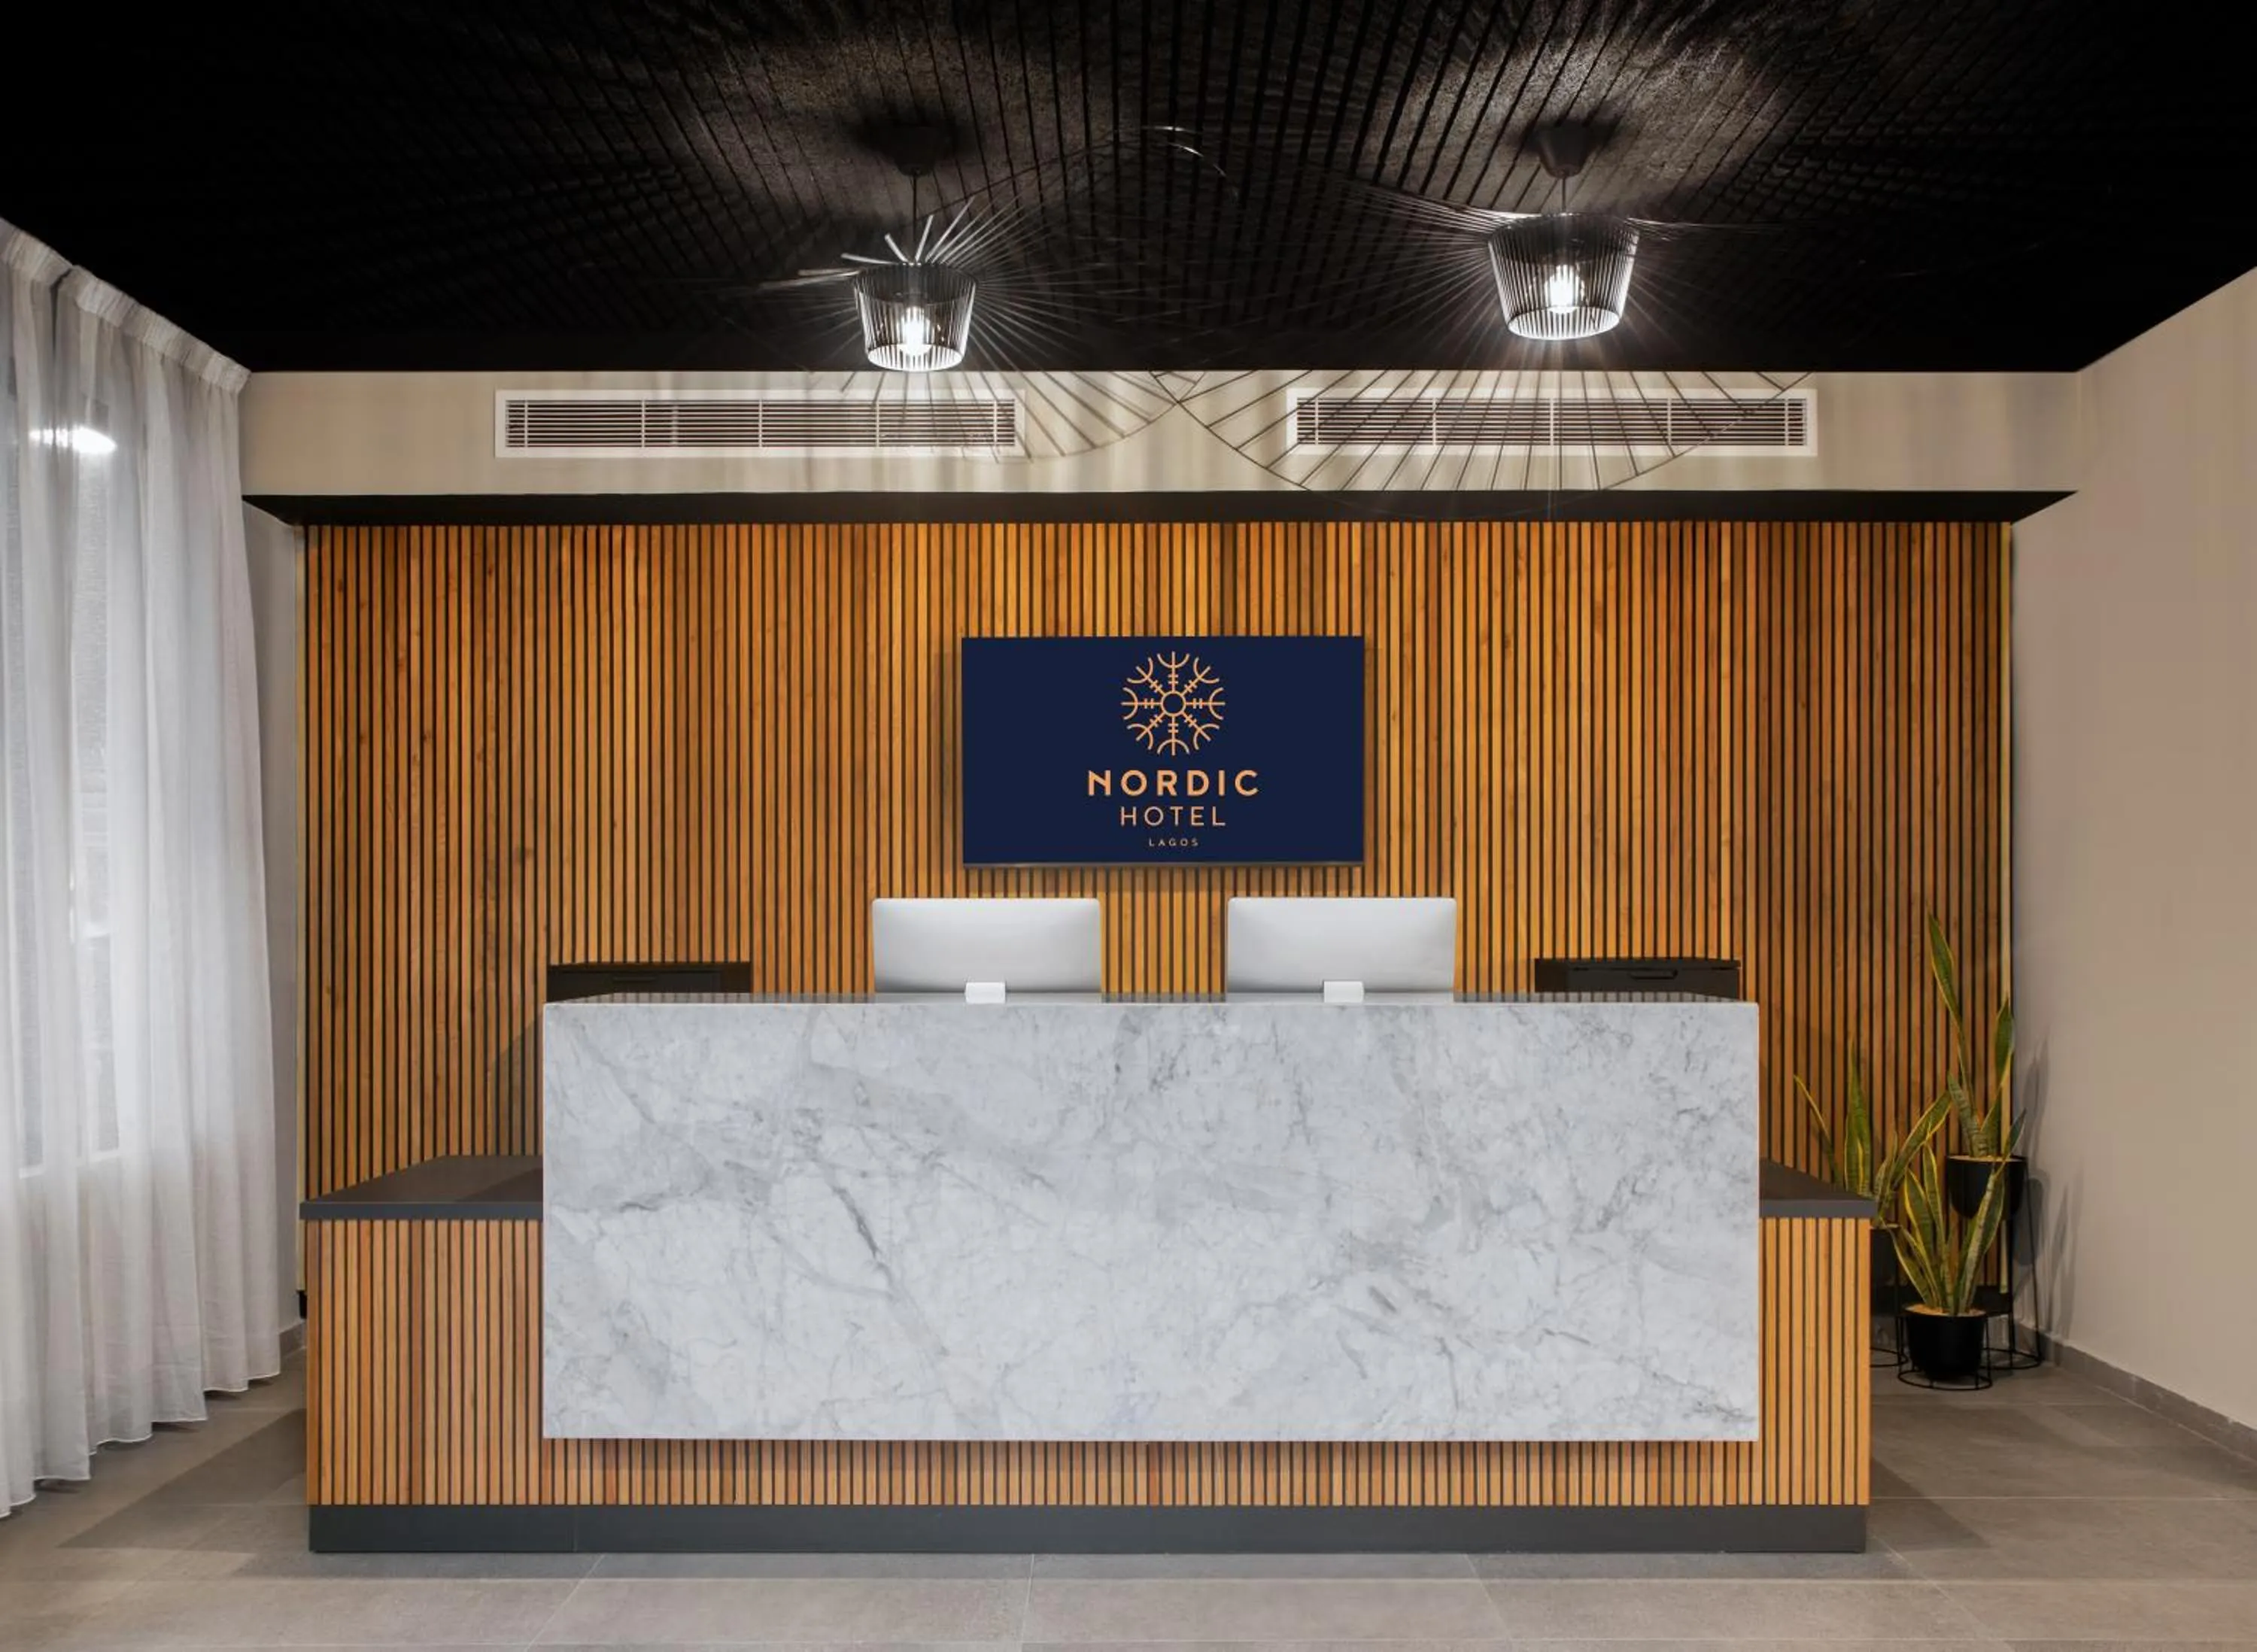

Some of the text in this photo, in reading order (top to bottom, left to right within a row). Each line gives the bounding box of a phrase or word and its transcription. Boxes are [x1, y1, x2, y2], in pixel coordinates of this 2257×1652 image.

[1088, 770, 1258, 796] NORDIC
[1120, 806, 1226, 826] HOTEL
[1148, 837, 1199, 847] LAGOS
